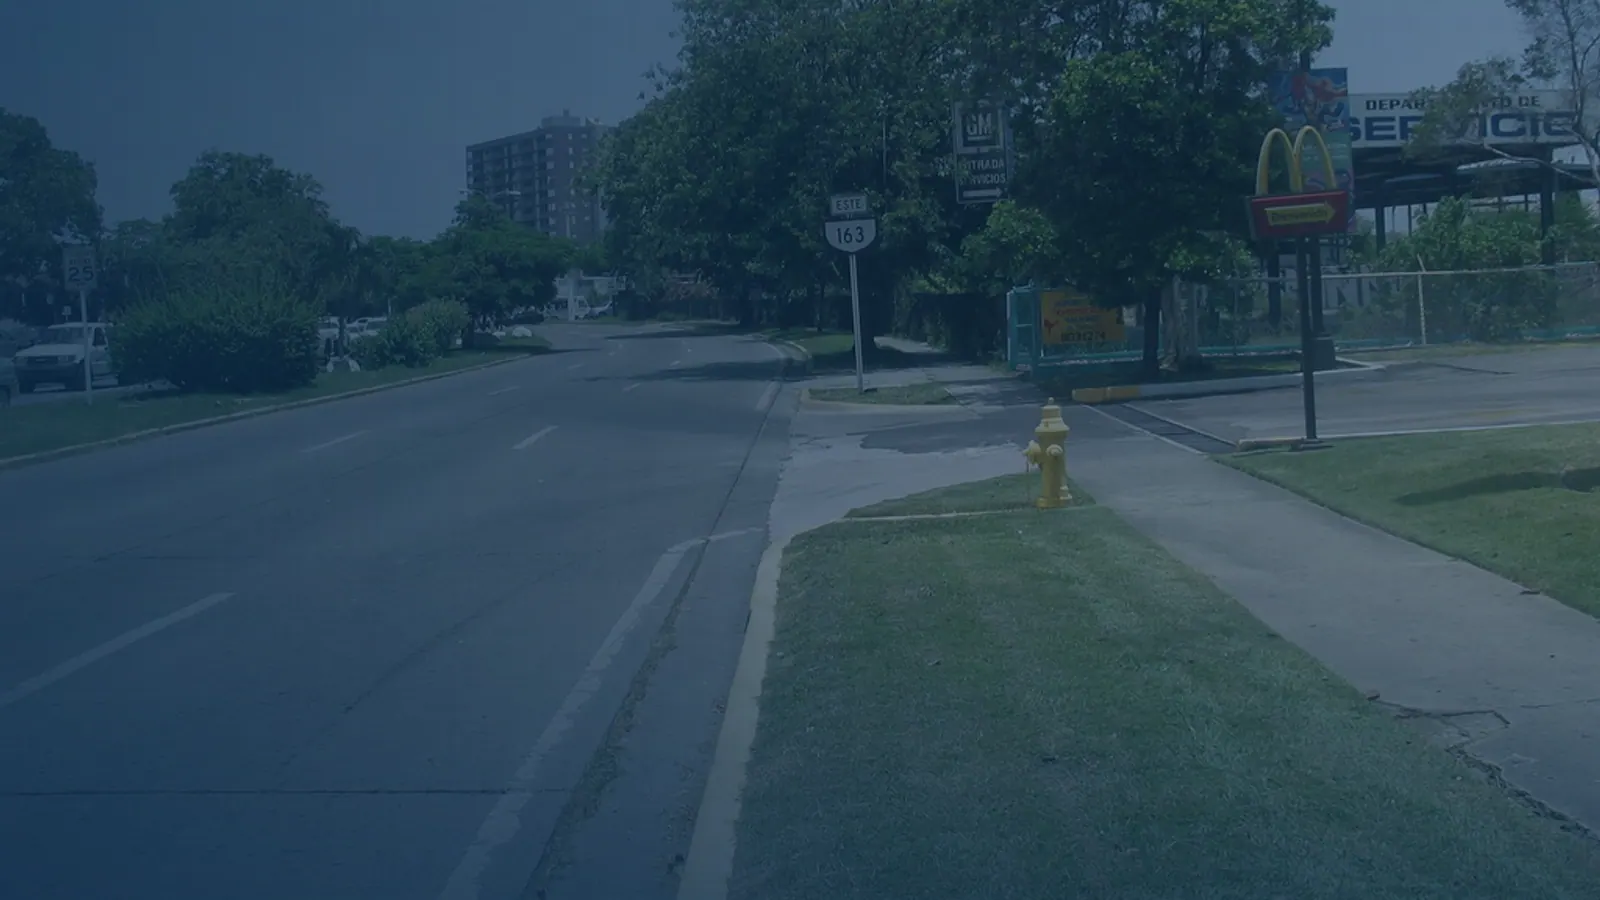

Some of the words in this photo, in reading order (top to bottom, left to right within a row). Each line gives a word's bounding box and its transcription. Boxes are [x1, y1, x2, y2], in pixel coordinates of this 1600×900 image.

[1518, 95, 1541, 108] DE
[966, 111, 992, 136] GM
[958, 157, 1005, 170] NTRADA
[958, 173, 1007, 186] SRVICIOS
[836, 198, 861, 211] ESTE
[836, 225, 865, 244] 163
[68, 266, 94, 282] 25
